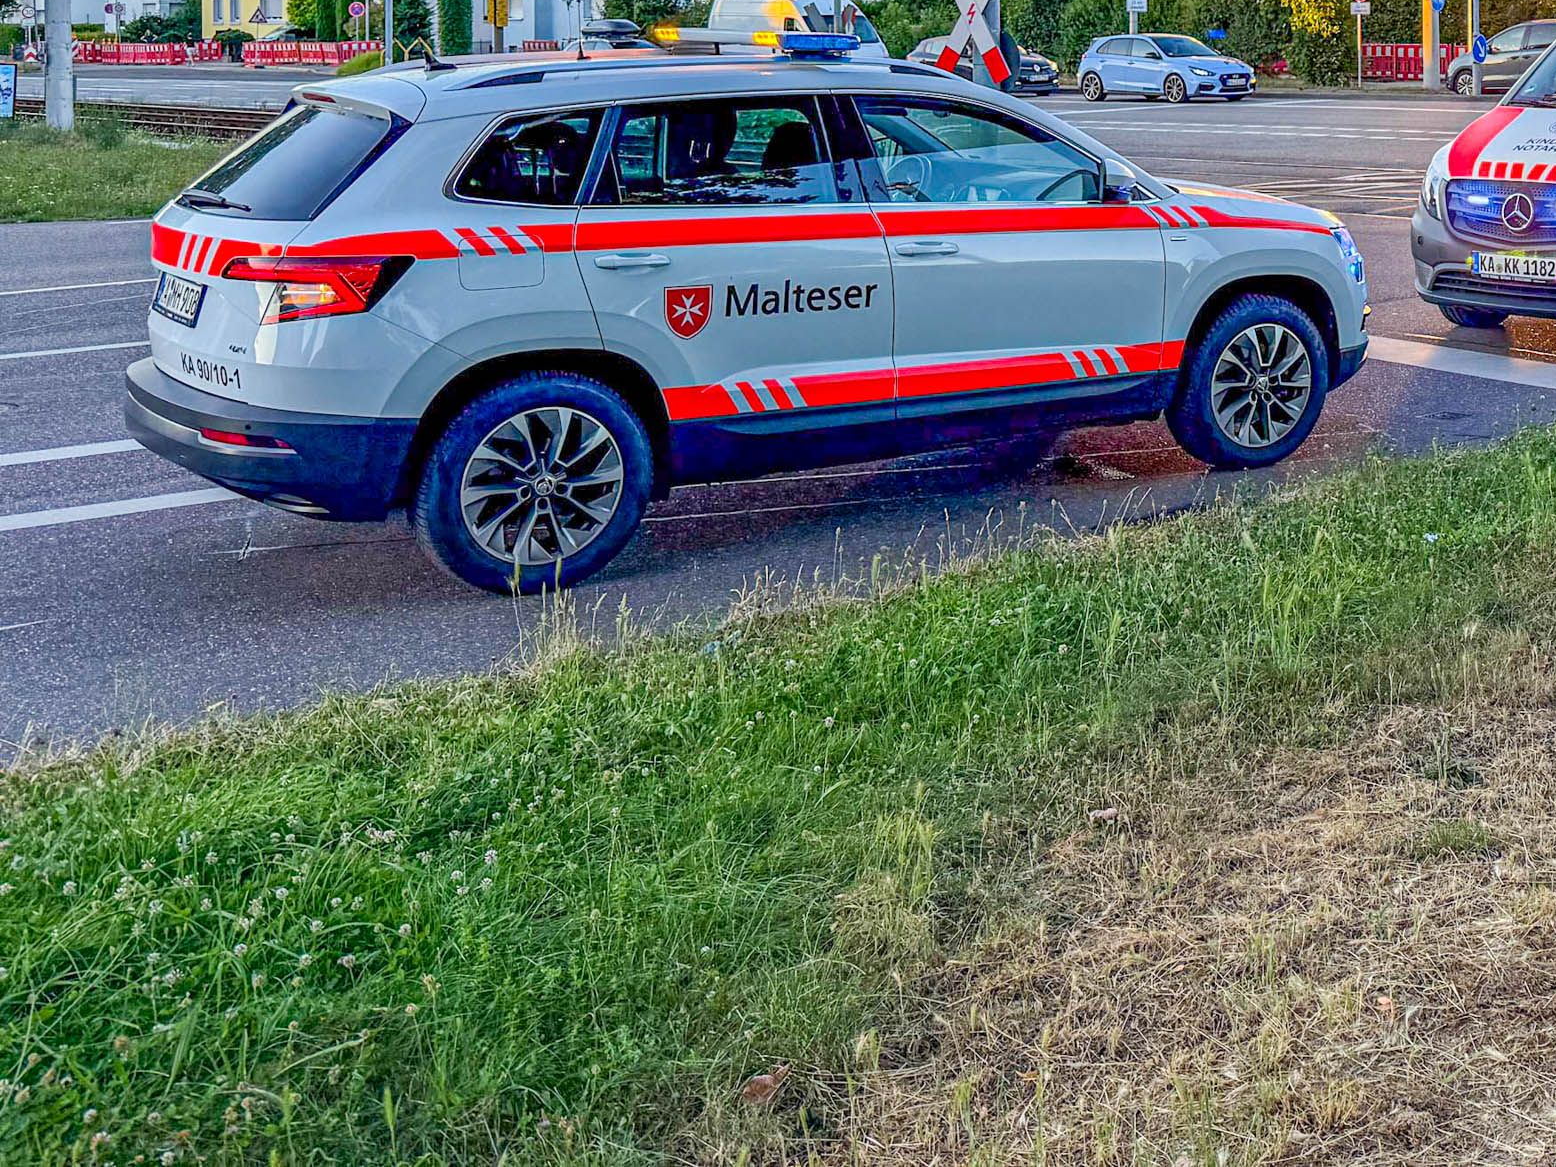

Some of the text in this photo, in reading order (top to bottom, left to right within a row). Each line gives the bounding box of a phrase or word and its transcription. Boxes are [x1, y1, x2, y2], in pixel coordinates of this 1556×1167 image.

[1480, 255, 1556, 277] KA KK 1182
[180, 285, 200, 316] 908
[724, 279, 878, 317] Malteser
[180, 351, 241, 390] KA 90/10-1
